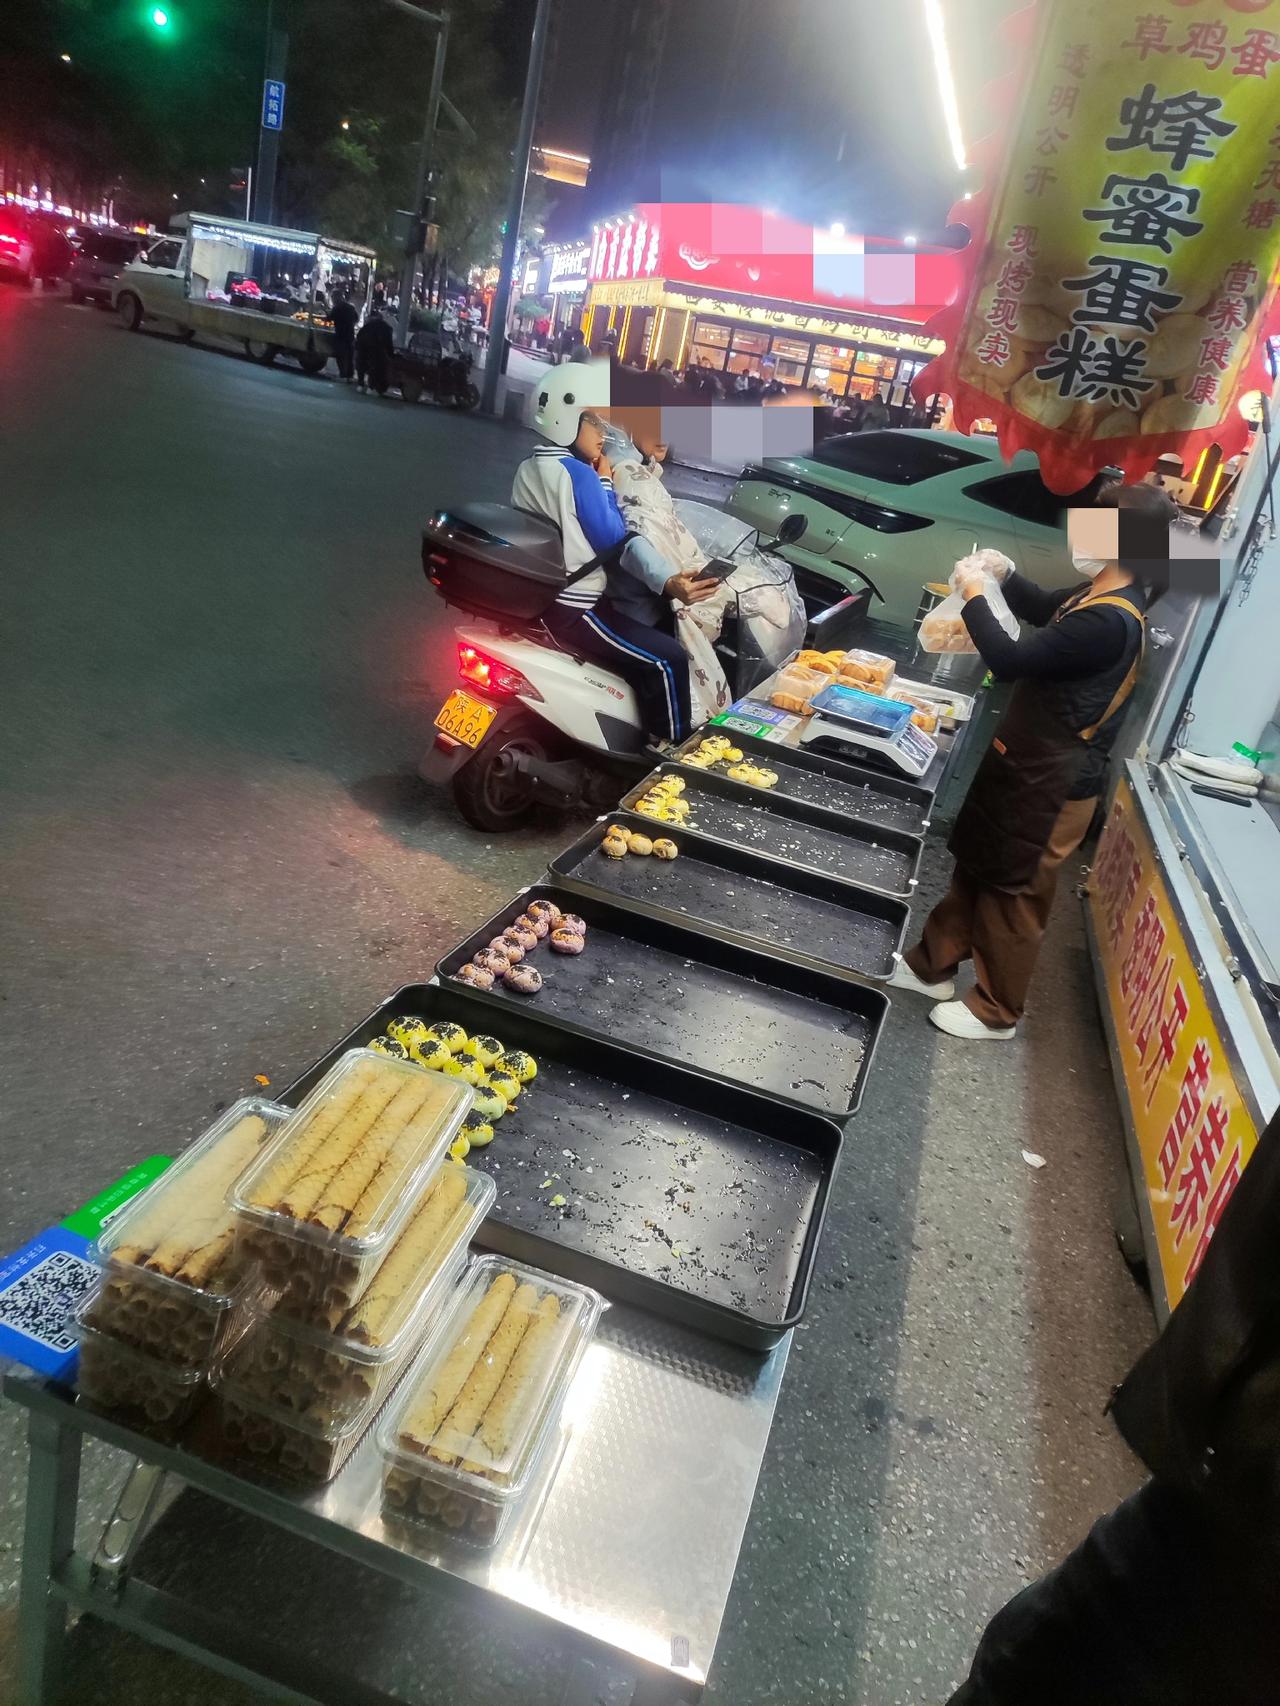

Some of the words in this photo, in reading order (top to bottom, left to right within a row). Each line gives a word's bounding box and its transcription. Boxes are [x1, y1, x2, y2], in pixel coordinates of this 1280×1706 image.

[1121, 13, 1280, 79] 草鸡蛋
[1024, 43, 1092, 199] 透明公开
[977, 223, 1040, 368] 现烤现卖
[1036, 83, 1237, 407] 蜂蜜蛋糕
[1185, 261, 1257, 406] 营养健康
[437, 708, 483, 744] 06A96
[1122, 894, 1189, 1110] 透明公开
